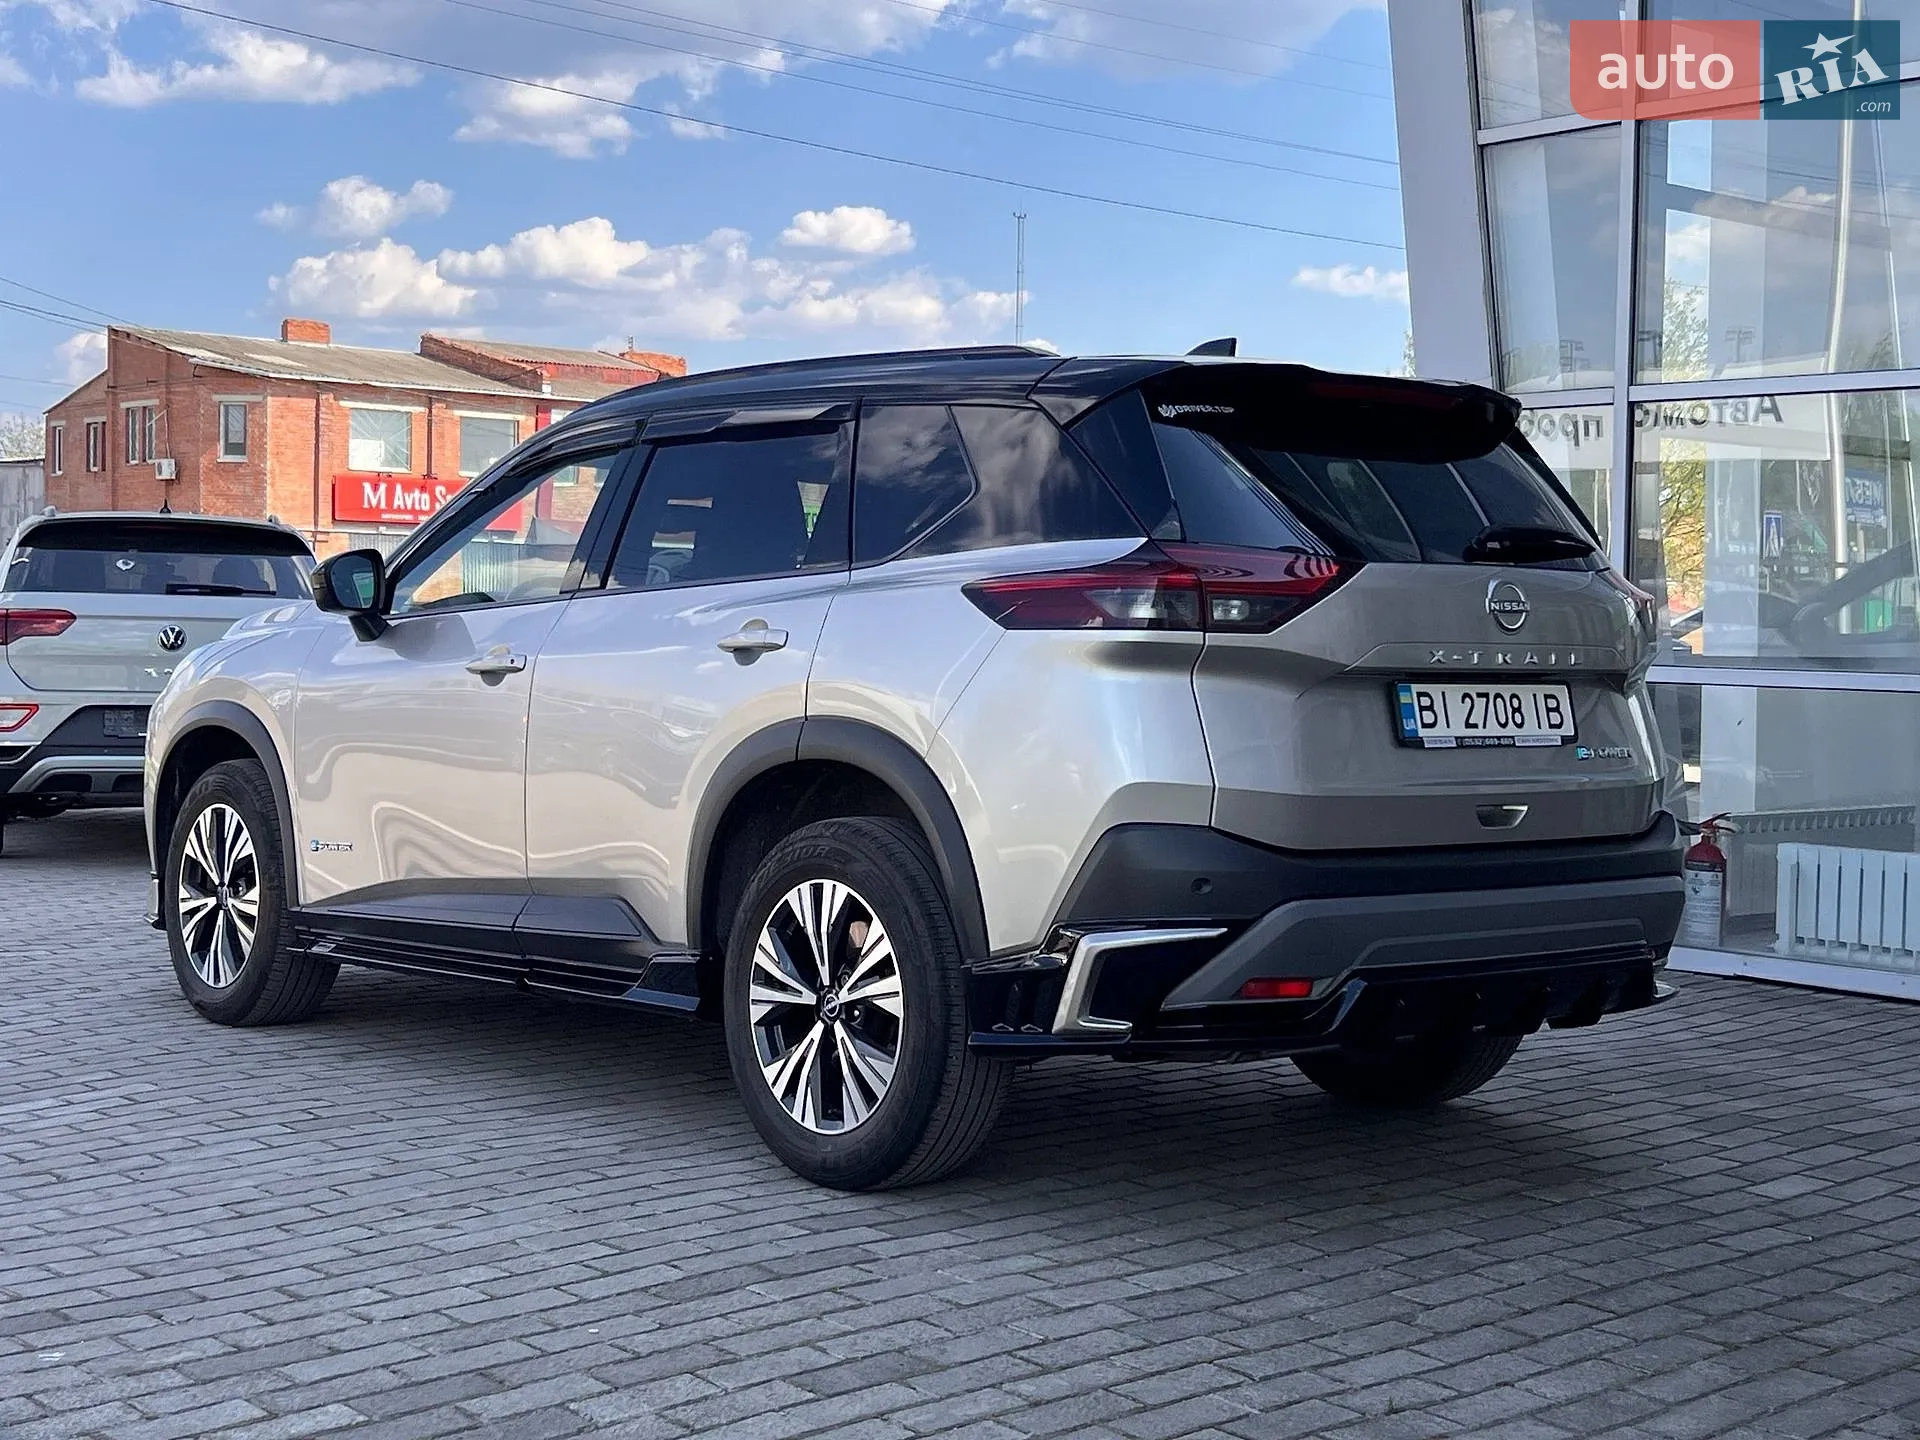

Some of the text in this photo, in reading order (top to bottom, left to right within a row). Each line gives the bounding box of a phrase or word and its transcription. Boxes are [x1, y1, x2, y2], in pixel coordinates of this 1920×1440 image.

[362, 481, 388, 509] M
[393, 483, 430, 511] Avto
[1490, 602, 1530, 611] NISSAN
[1428, 649, 1583, 666] X-TRAIL
[1416, 690, 1565, 730] BI 2708 IB
